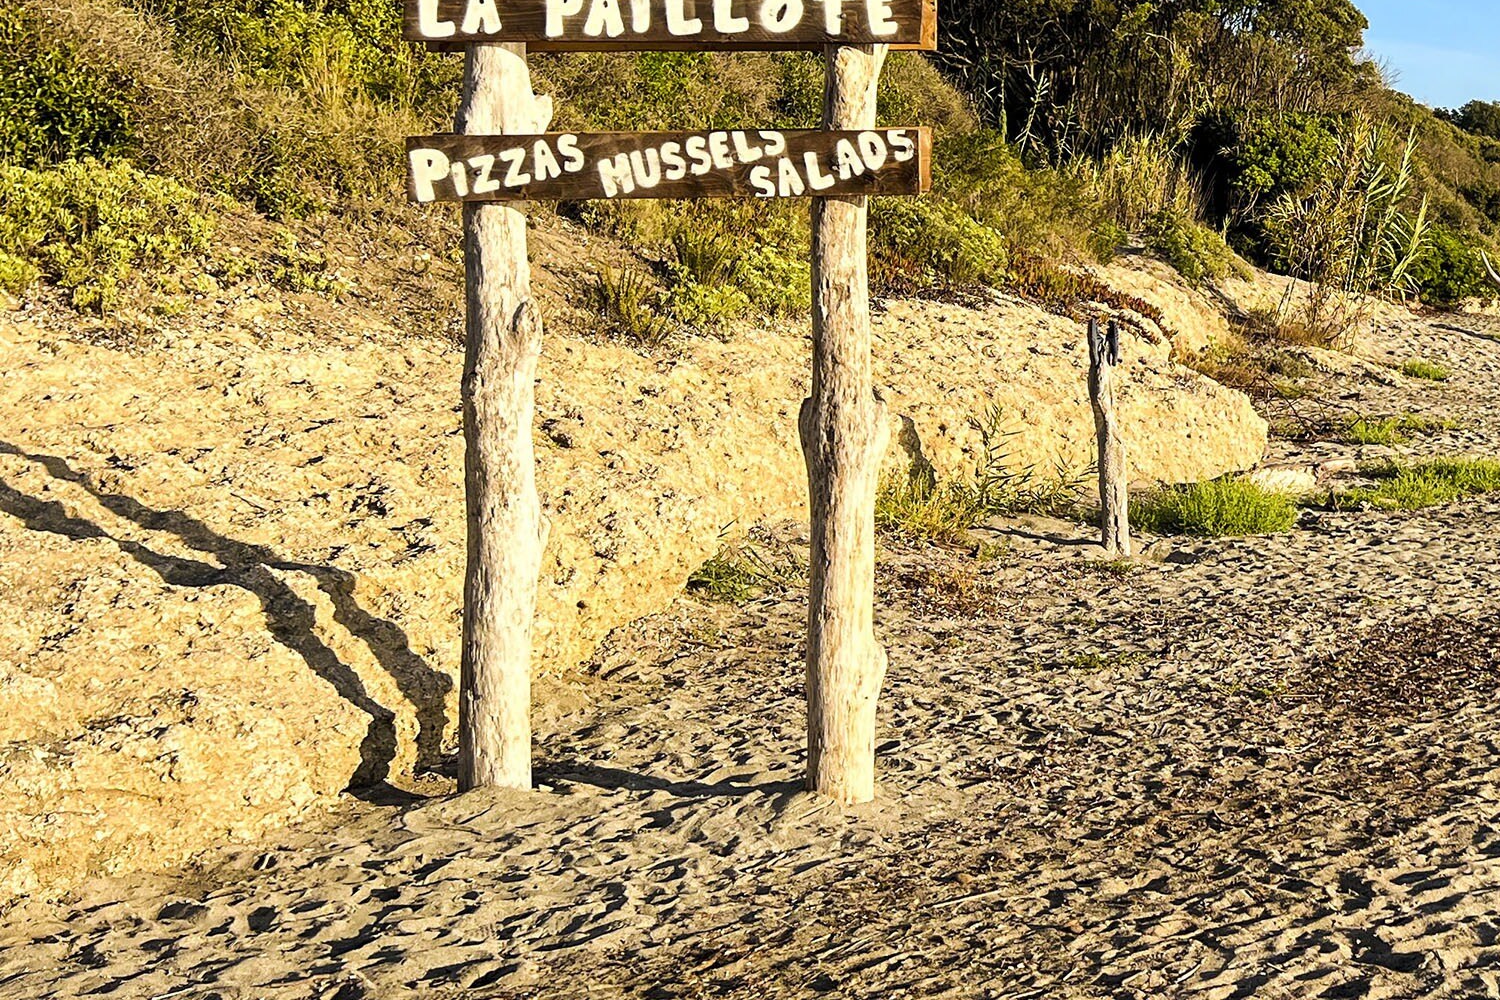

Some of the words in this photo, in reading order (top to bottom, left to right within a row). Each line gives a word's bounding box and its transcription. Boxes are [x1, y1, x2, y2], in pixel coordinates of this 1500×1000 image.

[408, 133, 585, 202] PIZZAS
[597, 130, 786, 198] MUSSELS
[749, 130, 915, 198] SALADS
